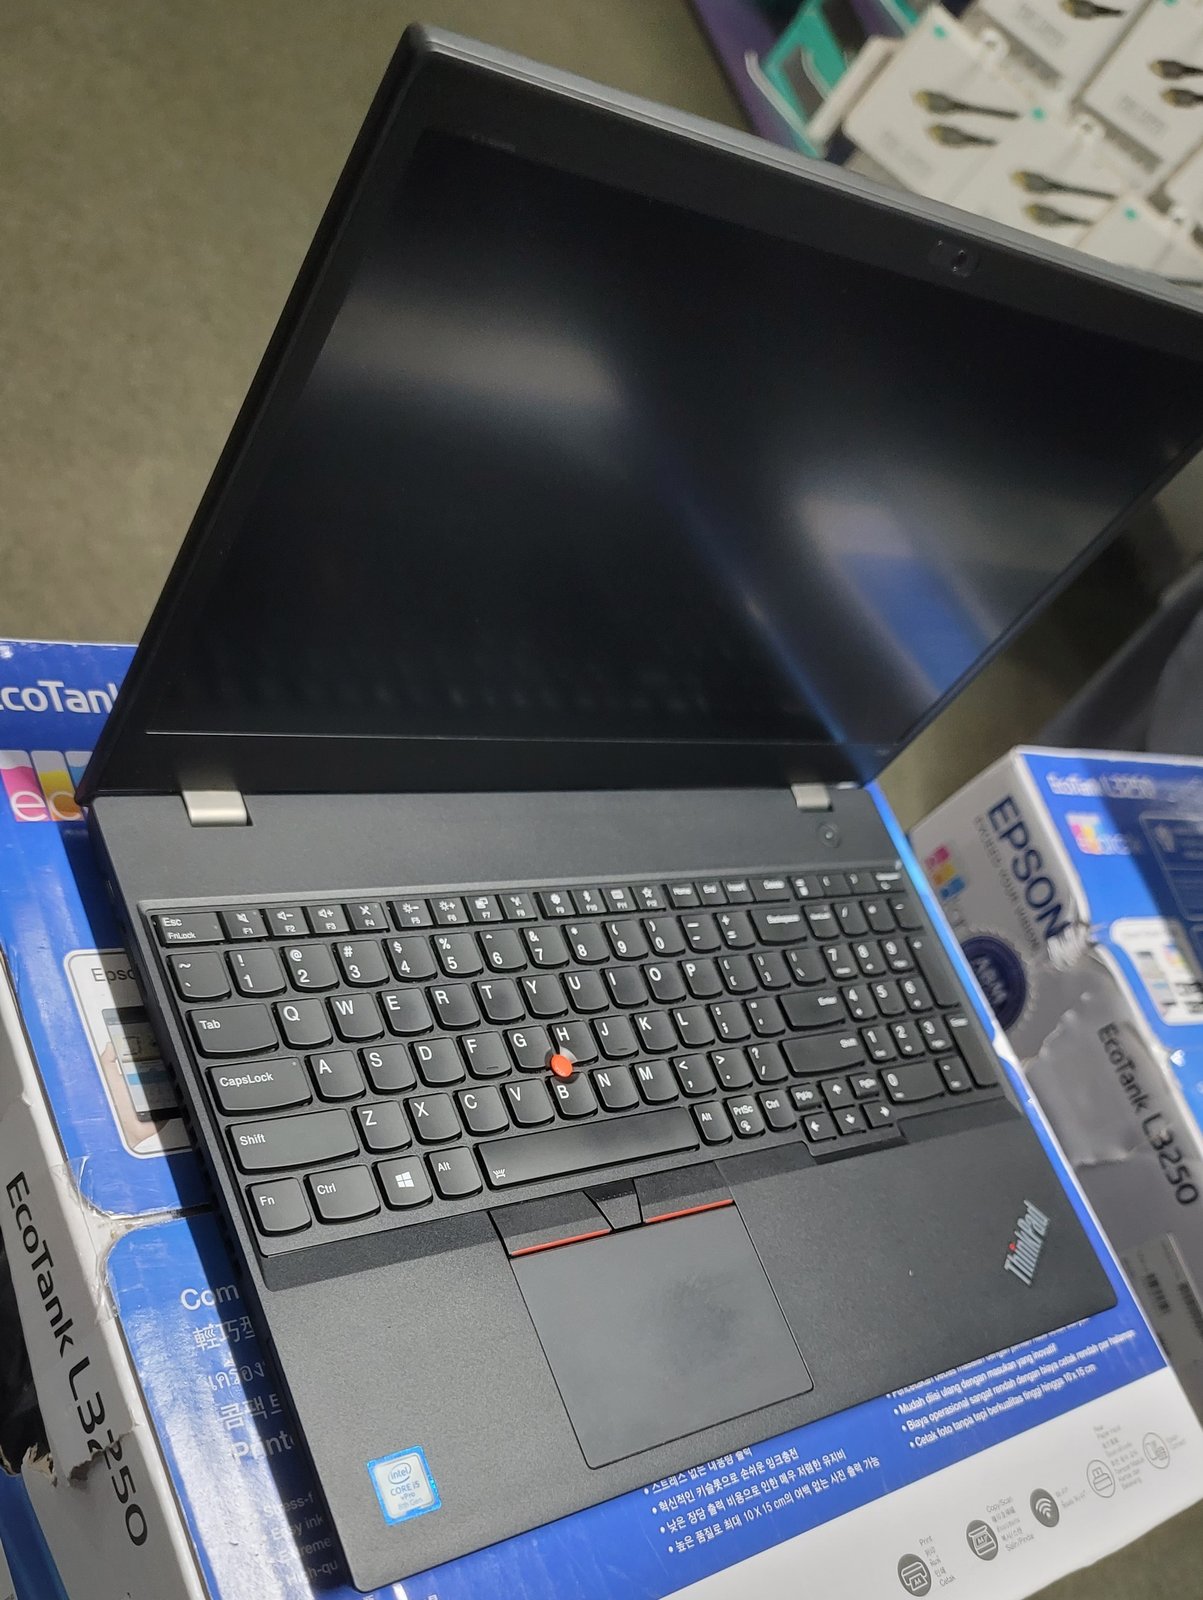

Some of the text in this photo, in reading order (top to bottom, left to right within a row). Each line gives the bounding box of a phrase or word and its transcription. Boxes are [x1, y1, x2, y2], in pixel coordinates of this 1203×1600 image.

[0, 680, 118, 714] coTan
[988, 795, 1071, 939] EPSON
[163, 917, 182, 927] Esc
[410, 916, 421, 924] F5
[482, 911, 491, 919] F7
[285, 925, 296, 933] F2
[326, 922, 337, 930] F3
[365, 919, 375, 927] F4
[168, 932, 196, 940] FnLock
[577, 944, 588, 957] 8
[617, 940, 627, 953] 9
[493, 951, 503, 965] 6
[535, 948, 543, 961] 7
[400, 960, 410, 973] 4
[447, 957, 458, 969] 5
[685, 963, 696, 977] P
[298, 970, 310, 983] 2
[349, 965, 361, 979] 3
[243, 974, 253, 988] 1
[526, 980, 537, 994] Y
[568, 976, 581, 990] U
[434, 990, 450, 1004] R
[481, 985, 493, 1000] T
[876, 985, 888, 998] 5
[336, 1000, 354, 1015] W
[386, 995, 401, 1010] E
[283, 1005, 300, 1021] Q
[677, 1013, 689, 1026] L
[200, 1020, 221, 1030] Tab
[602, 1022, 609, 1036] J
[639, 1017, 652, 1030] K
[923, 1021, 935, 1034] 3
[556, 1027, 570, 1041] H
[896, 1026, 908, 1038] 2
[467, 1039, 477, 1053] F
[513, 1033, 528, 1048] G
[370, 1053, 383, 1067] S
[418, 1046, 432, 1060] D
[319, 1059, 332, 1074] A
[639, 1067, 653, 1080] M
[220, 1073, 274, 1087] CapsLock
[597, 1073, 611, 1087] N
[509, 1087, 520, 1101] V
[557, 1085, 569, 1099] B
[464, 1094, 477, 1109] C
[766, 1099, 780, 1110] Ctrl
[414, 1102, 429, 1117] X
[701, 1112, 712, 1121] Alt
[1098, 1022, 1198, 1206] EcoTank L3250
[362, 1110, 377, 1126] Z
[239, 1134, 266, 1146] Shift
[438, 1162, 451, 1172] Alt
[317, 1183, 336, 1195] Ctrl
[260, 1196, 275, 1206] Fn
[1004, 1199, 1050, 1286] ThinkPad
[6, 1171, 147, 1546] EcoTank L3250
[208, 1352, 265, 1391] เครื่อง
[898, 1397, 926, 1415] Mudah
[961, 1373, 988, 1388] dengan
[906, 1416, 929, 1430] Biaya
[928, 1397, 970, 1422] operasional
[914, 1430, 938, 1447] Cetak
[937, 1424, 953, 1438] foto
[952, 1415, 975, 1431] tanpa
[391, 1467, 408, 1480] intel
[658, 1489, 695, 1512] 혁신적인
[740, 1461, 765, 1480] 손쉬운
[765, 1447, 799, 1470] 잉크충전
[390, 1484, 412, 1496] CORE
[652, 1473, 688, 1494] 스트레스
[666, 1516, 686, 1533] 낮은
[707, 1499, 726, 1516] 출력
[726, 1485, 761, 1506] 비용으로
[761, 1477, 779, 1493] 인한
[779, 1469, 796, 1485] 매우
[797, 1459, 822, 1478] 저렴한
[822, 1448, 847, 1467] 유지비
[400, 1492, 416, 1500] vPro
[675, 1535, 695, 1553] 높은
[695, 1523, 723, 1544] 품질로
[724, 1514, 742, 1530] 최대
[743, 1510, 754, 1522] 10
[762, 1501, 772, 1514] 15
[773, 1492, 794, 1509] cm의
[794, 1485, 812, 1499] 여백
[811, 1478, 829, 1493] 없는
[830, 1469, 847, 1484] 사진
[847, 1462, 863, 1478] 출력
[863, 1456, 880, 1469] 가능
